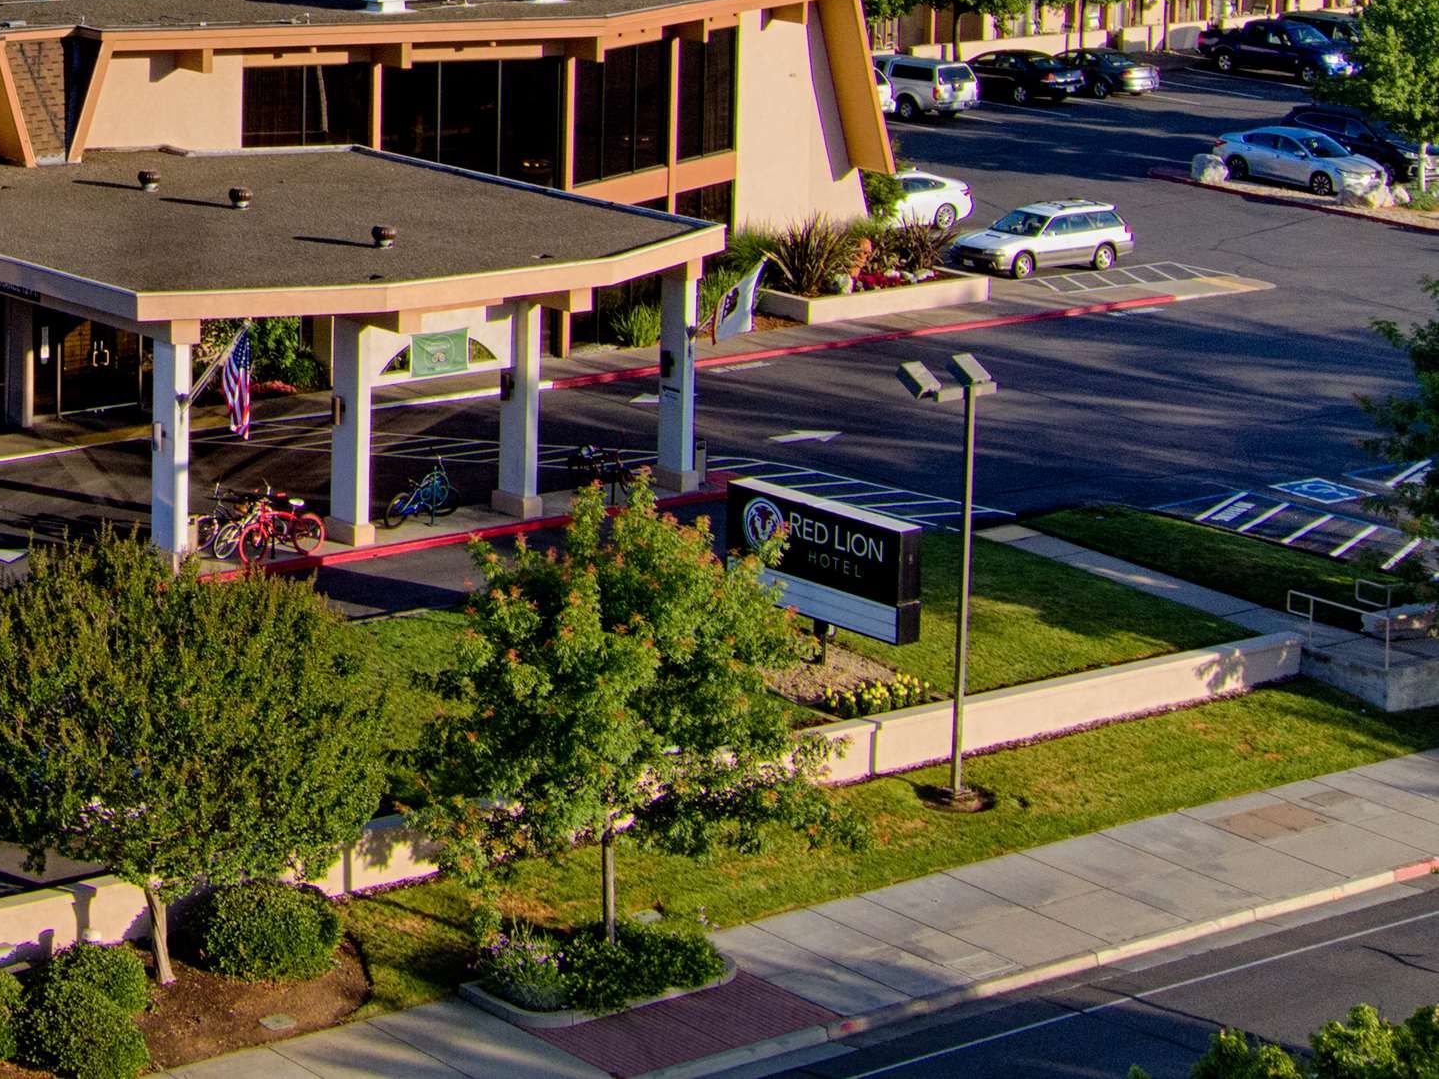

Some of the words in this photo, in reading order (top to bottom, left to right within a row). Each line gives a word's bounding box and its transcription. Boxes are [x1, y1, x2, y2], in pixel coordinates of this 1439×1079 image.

[789, 511, 828, 544] RED
[835, 525, 883, 562] LION
[808, 550, 862, 578] HOTEL
